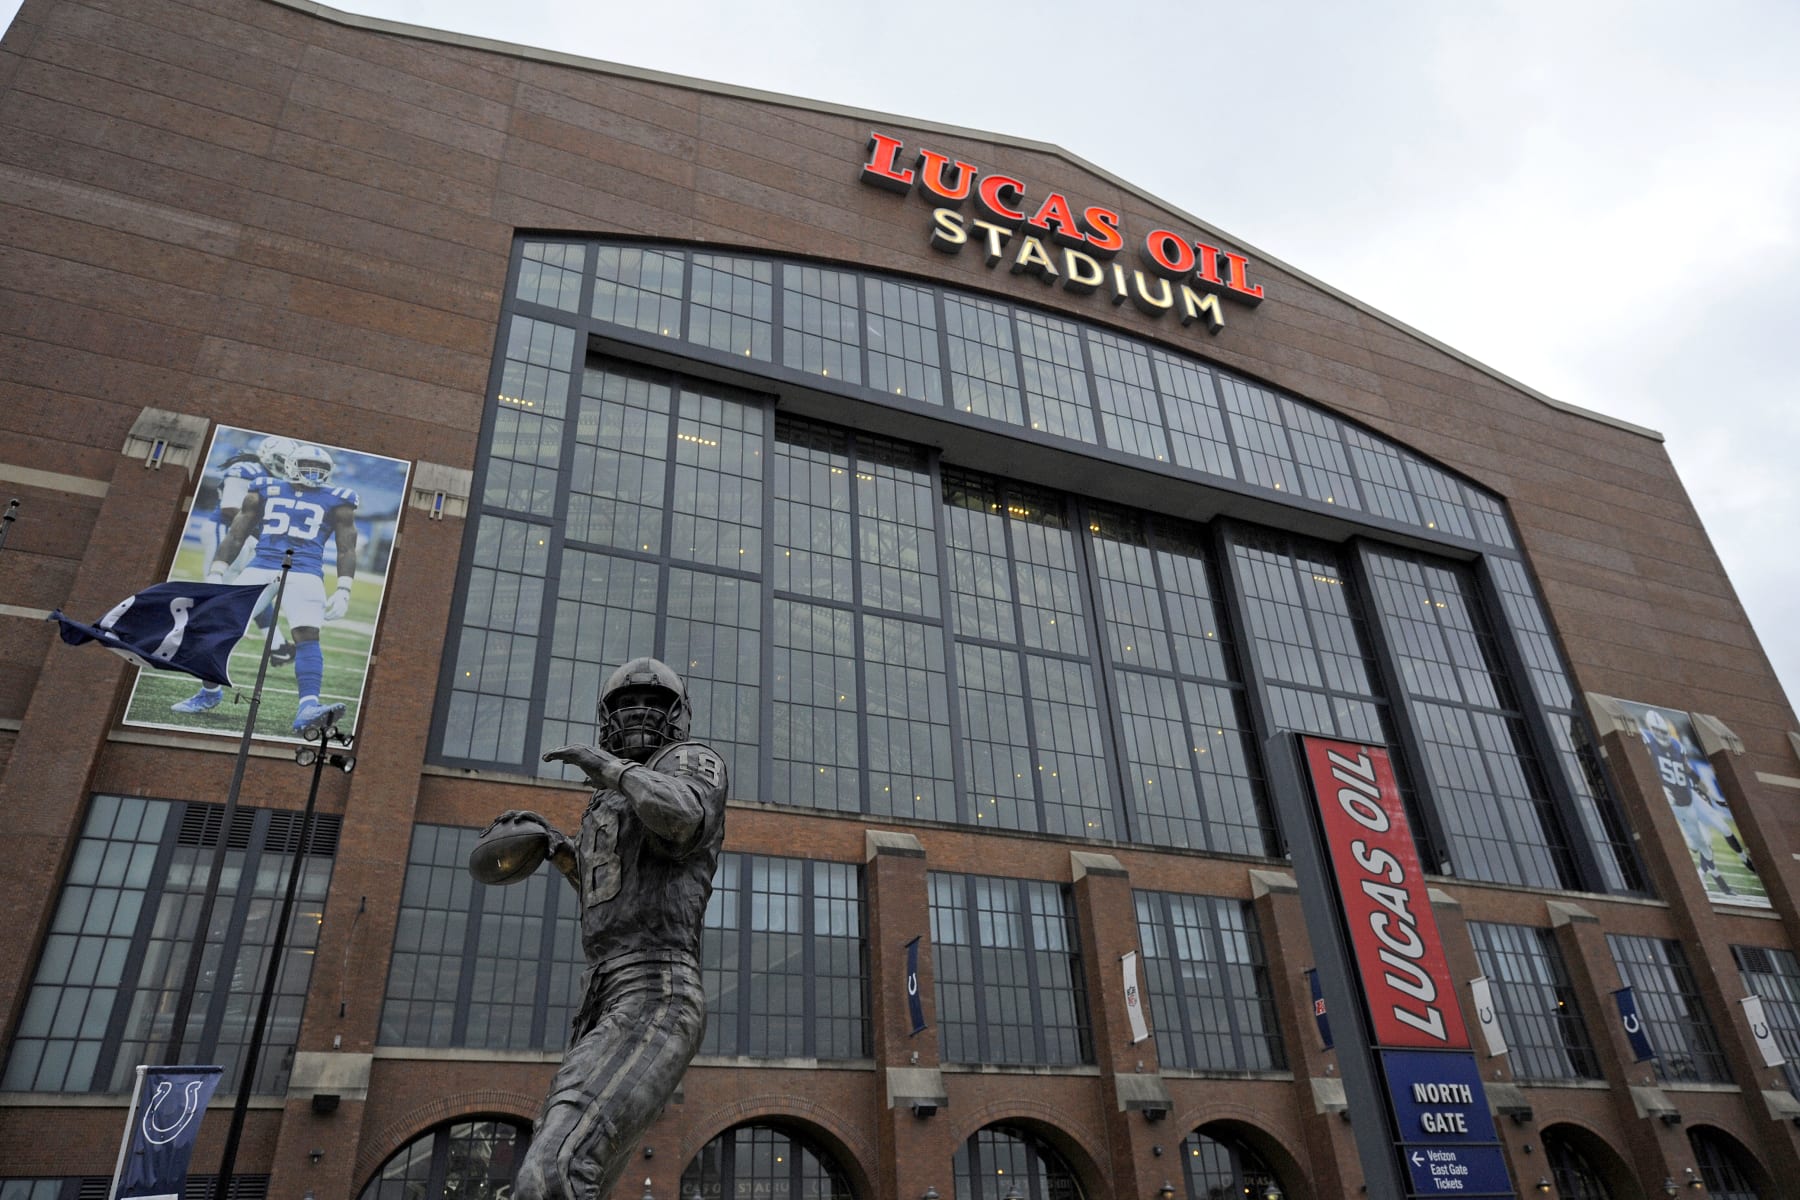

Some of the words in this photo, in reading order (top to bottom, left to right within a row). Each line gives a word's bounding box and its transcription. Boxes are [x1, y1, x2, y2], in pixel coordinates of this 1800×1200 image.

[862, 132, 1124, 254] LUCAS
[1144, 229, 1265, 301] OIL
[932, 207, 1226, 332] STADIUM
[262, 497, 325, 540] 53
[675, 750, 721, 787] 18
[1658, 756, 1687, 787] 56
[1326, 748, 1391, 834] OIL
[1351, 838, 1449, 1042] LUCAS
[1412, 1083, 1474, 1104] NORTH
[1421, 1112, 1468, 1133] GATE
[1427, 1150, 1457, 1161] Verizon
[1430, 1163, 1450, 1176] East
[1449, 1163, 1469, 1176] Gate
[1434, 1178, 1464, 1190] Tickets
